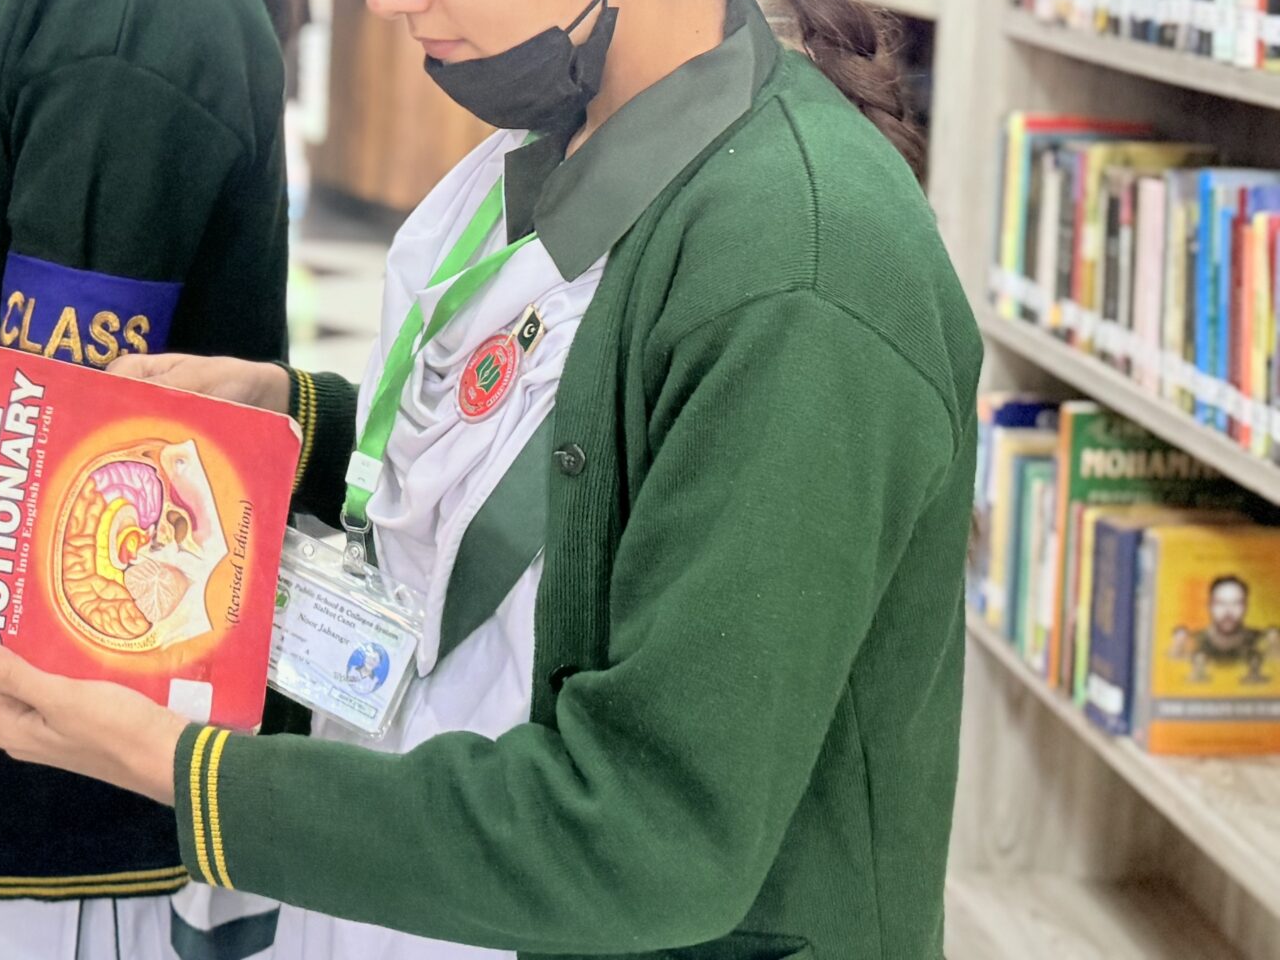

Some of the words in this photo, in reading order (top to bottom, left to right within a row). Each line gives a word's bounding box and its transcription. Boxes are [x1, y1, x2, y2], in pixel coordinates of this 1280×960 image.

[1, 291, 151, 367] CLASS
[37, 405, 55, 445] Urdu
[34, 449, 47, 479] and
[22, 479, 42, 539] English
[232, 499, 255, 561] Edition)
[16, 542, 31, 575] into
[7, 577, 25, 636] English
[224, 559, 245, 625] (Revised
[316, 593, 339, 610] School
